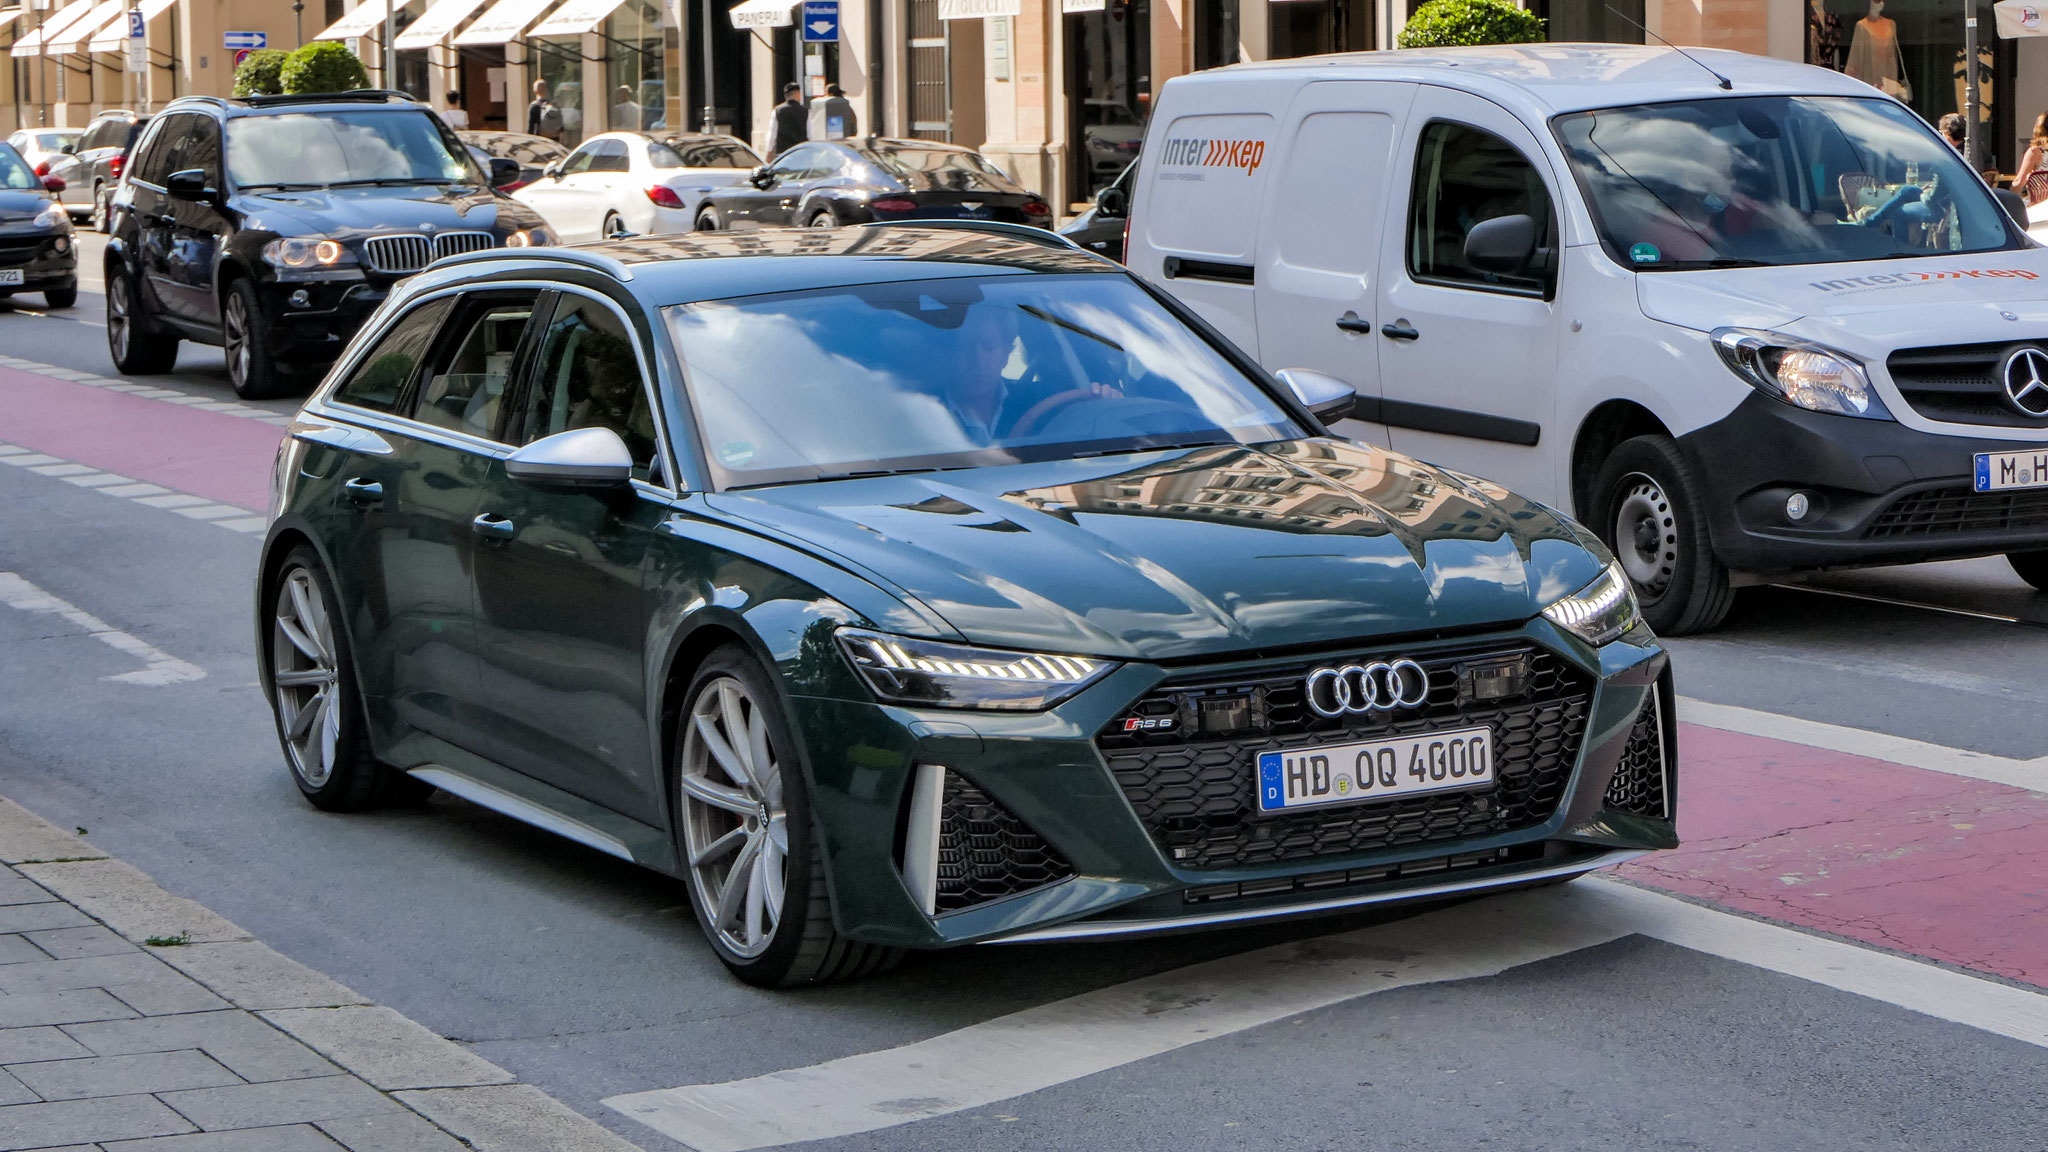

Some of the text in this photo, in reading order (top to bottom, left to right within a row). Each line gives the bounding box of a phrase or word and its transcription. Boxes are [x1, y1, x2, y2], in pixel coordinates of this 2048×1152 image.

[130, 15, 140, 35] P
[1980, 455, 2048, 484] D M H
[1128, 718, 1172, 730] RS 6
[1268, 736, 1487, 799] D HD OQ 4000
